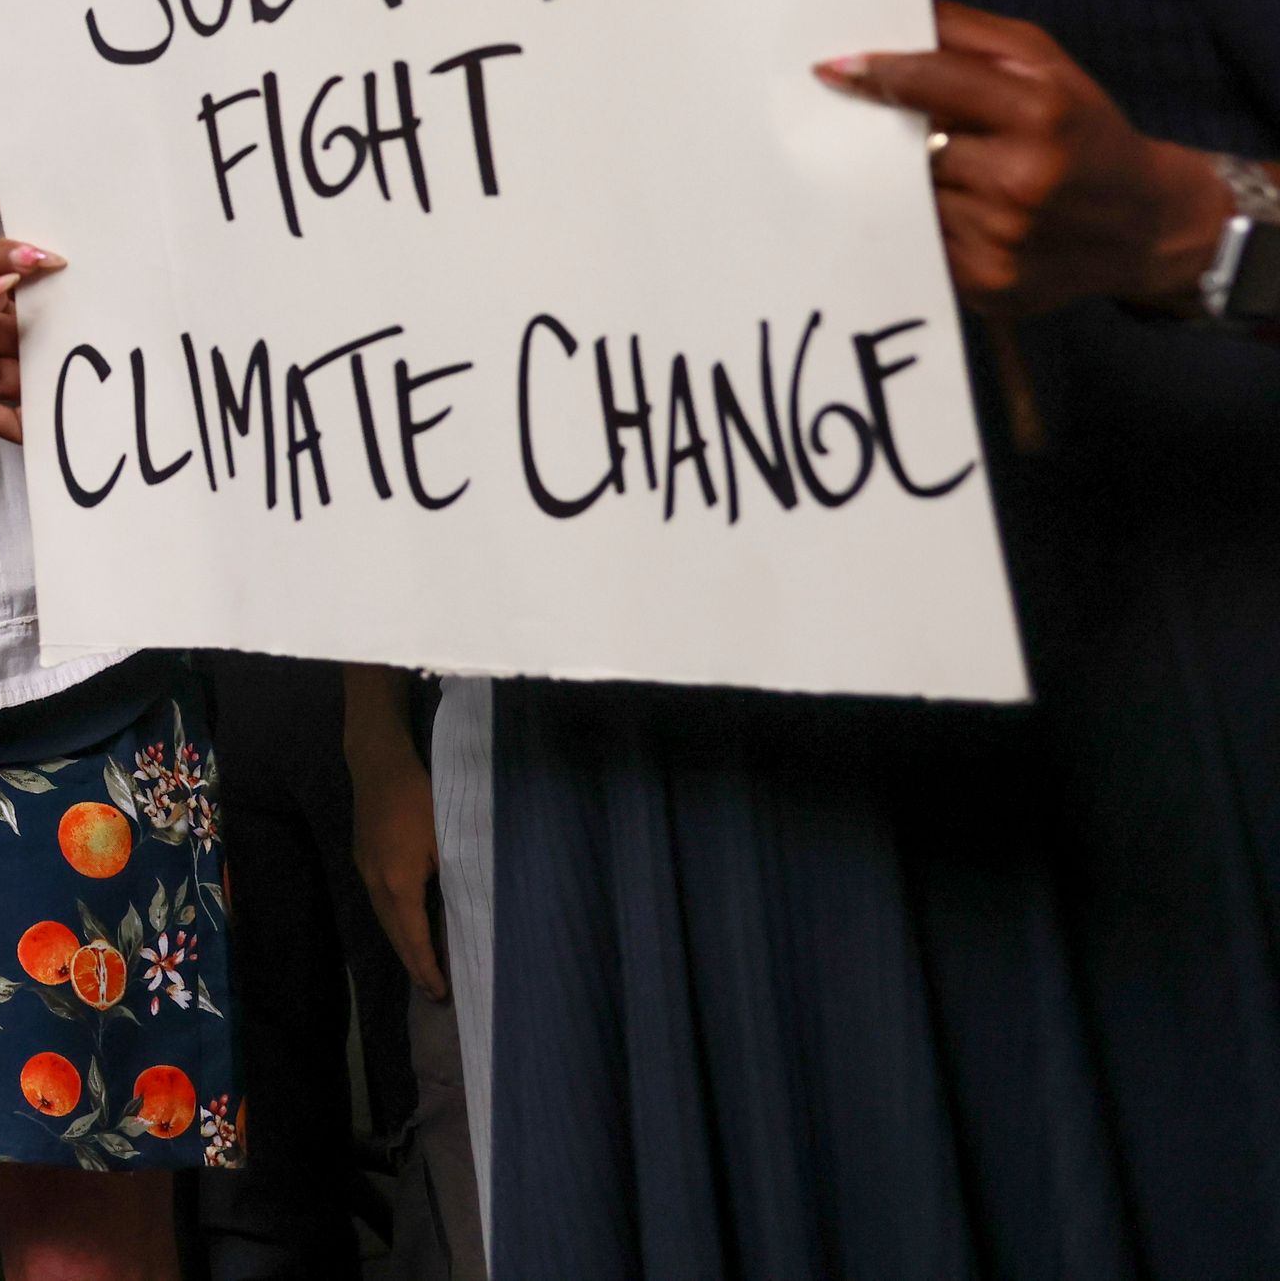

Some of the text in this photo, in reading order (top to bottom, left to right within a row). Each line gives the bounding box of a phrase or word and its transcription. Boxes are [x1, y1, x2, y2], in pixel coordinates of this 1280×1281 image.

[196, 42, 523, 238] FIGHT
[54, 309, 976, 526] CLIMATE CHANGE
